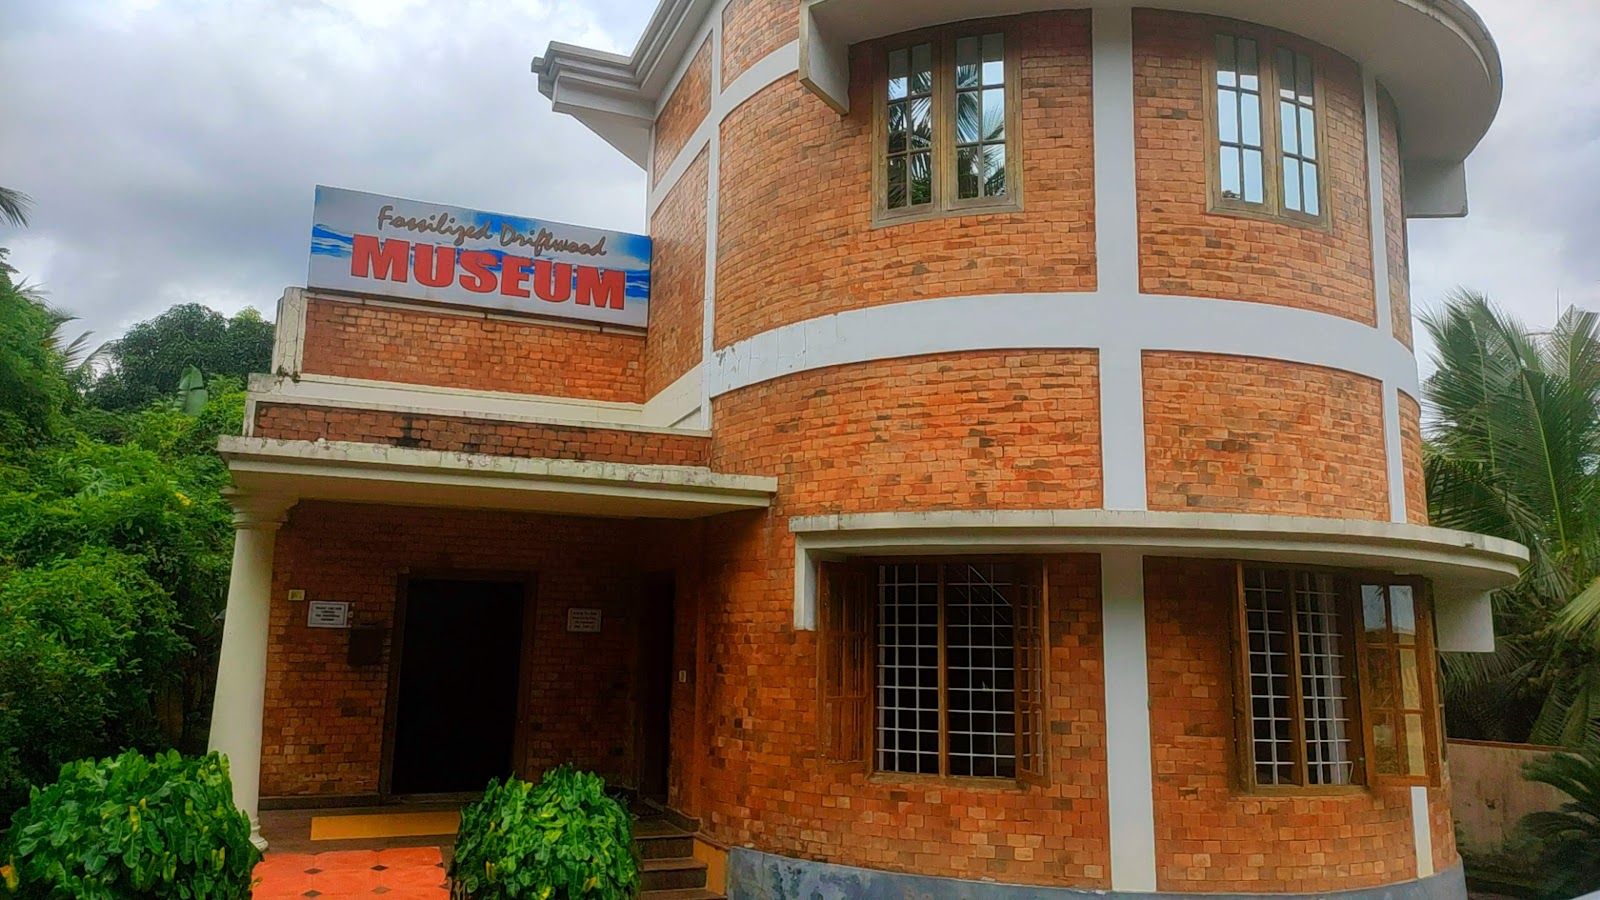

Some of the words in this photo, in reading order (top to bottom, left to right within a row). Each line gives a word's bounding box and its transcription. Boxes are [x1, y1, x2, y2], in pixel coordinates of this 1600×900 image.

[378, 205, 492, 246] Fossilized
[500, 222, 607, 257] Driftwood
[351, 233, 626, 310] MUSEUM
